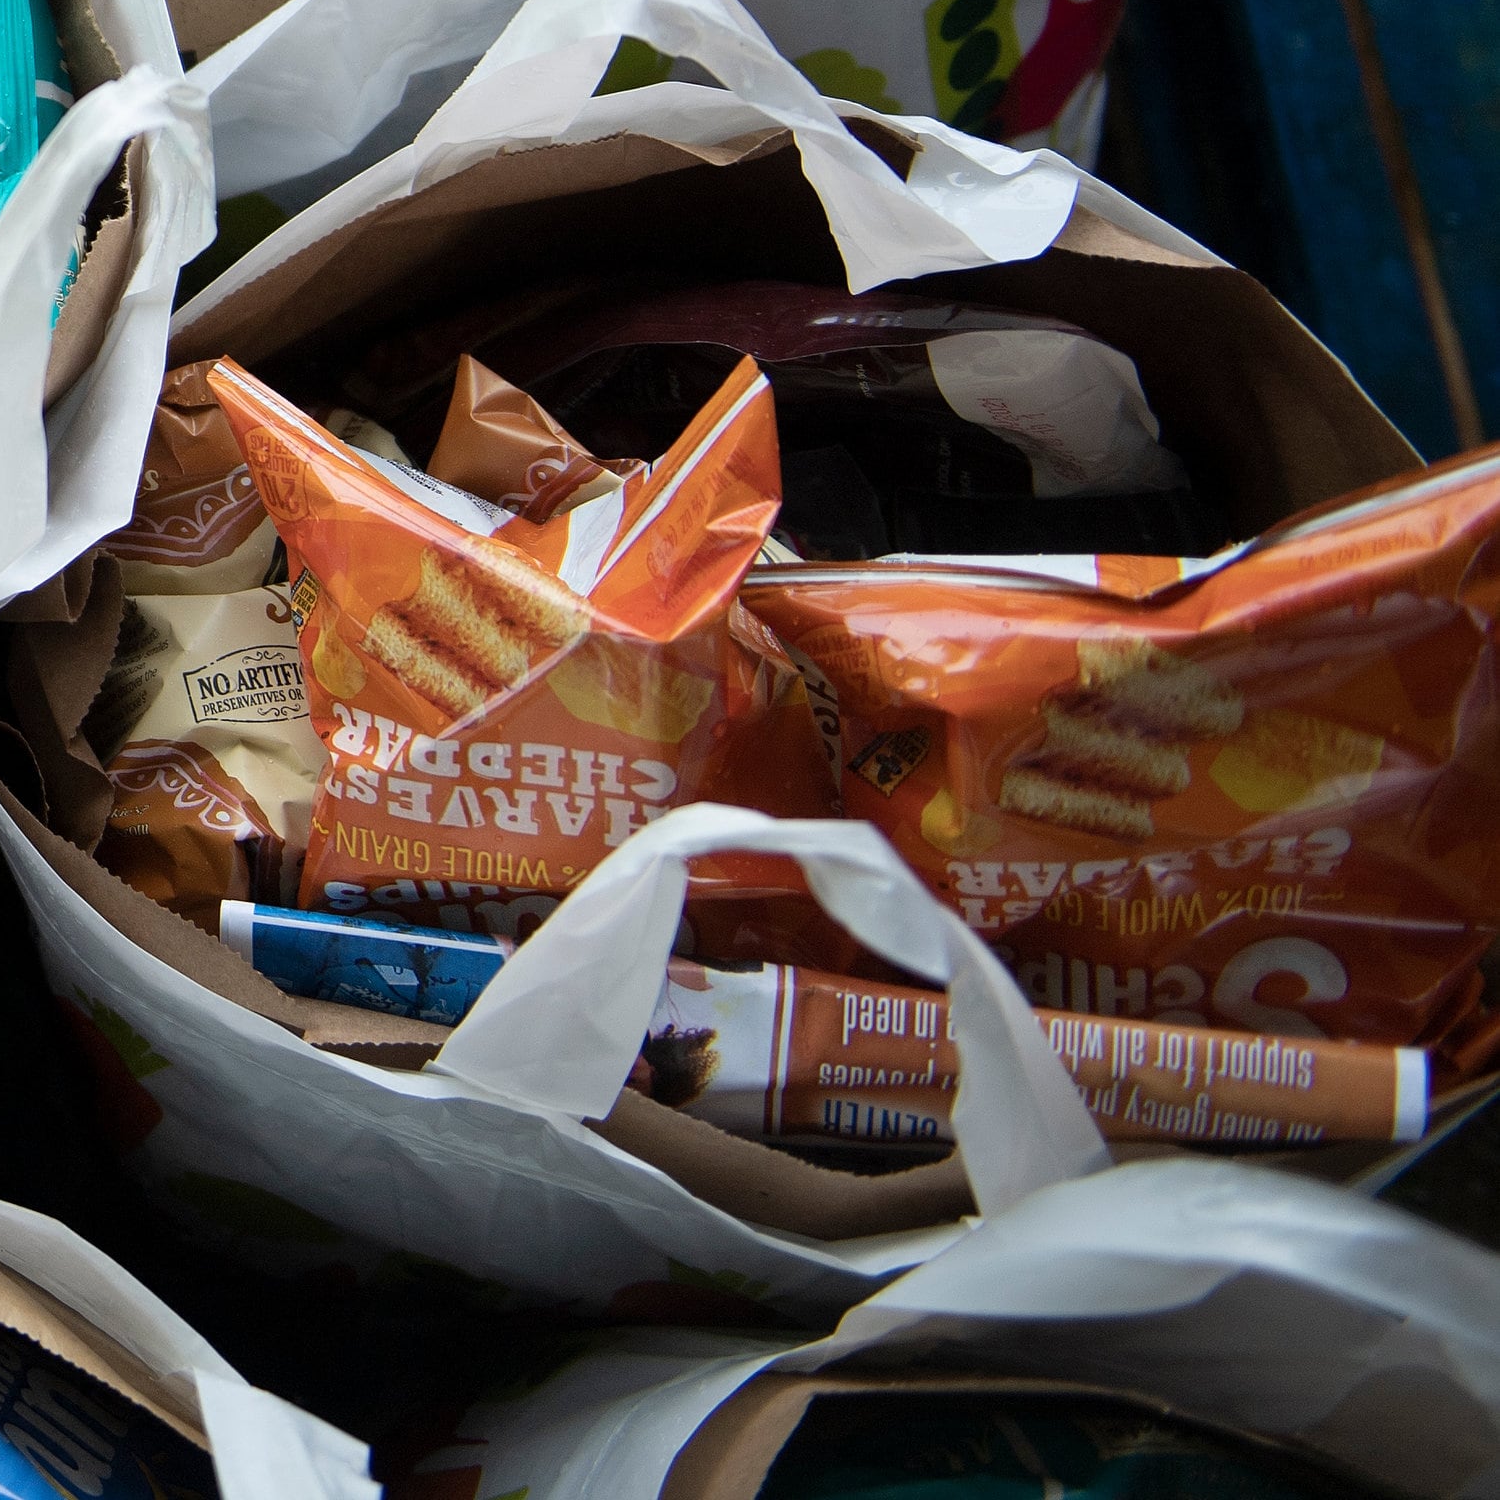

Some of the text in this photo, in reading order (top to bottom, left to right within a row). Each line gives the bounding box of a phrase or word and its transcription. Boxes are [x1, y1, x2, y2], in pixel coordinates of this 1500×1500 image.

[197, 672, 231, 700] NO
[202, 688, 305, 717] PRESERVATIVES OR
[329, 703, 678, 802] CHEDDAR
[334, 821, 552, 887] WHOLE GRAIN
[1093, 882, 1304, 936] 100% WHOLE
[834, 990, 938, 1046] in need.
[1047, 1016, 1315, 1092] support for all who
[822, 1098, 941, 1138] CENTER
